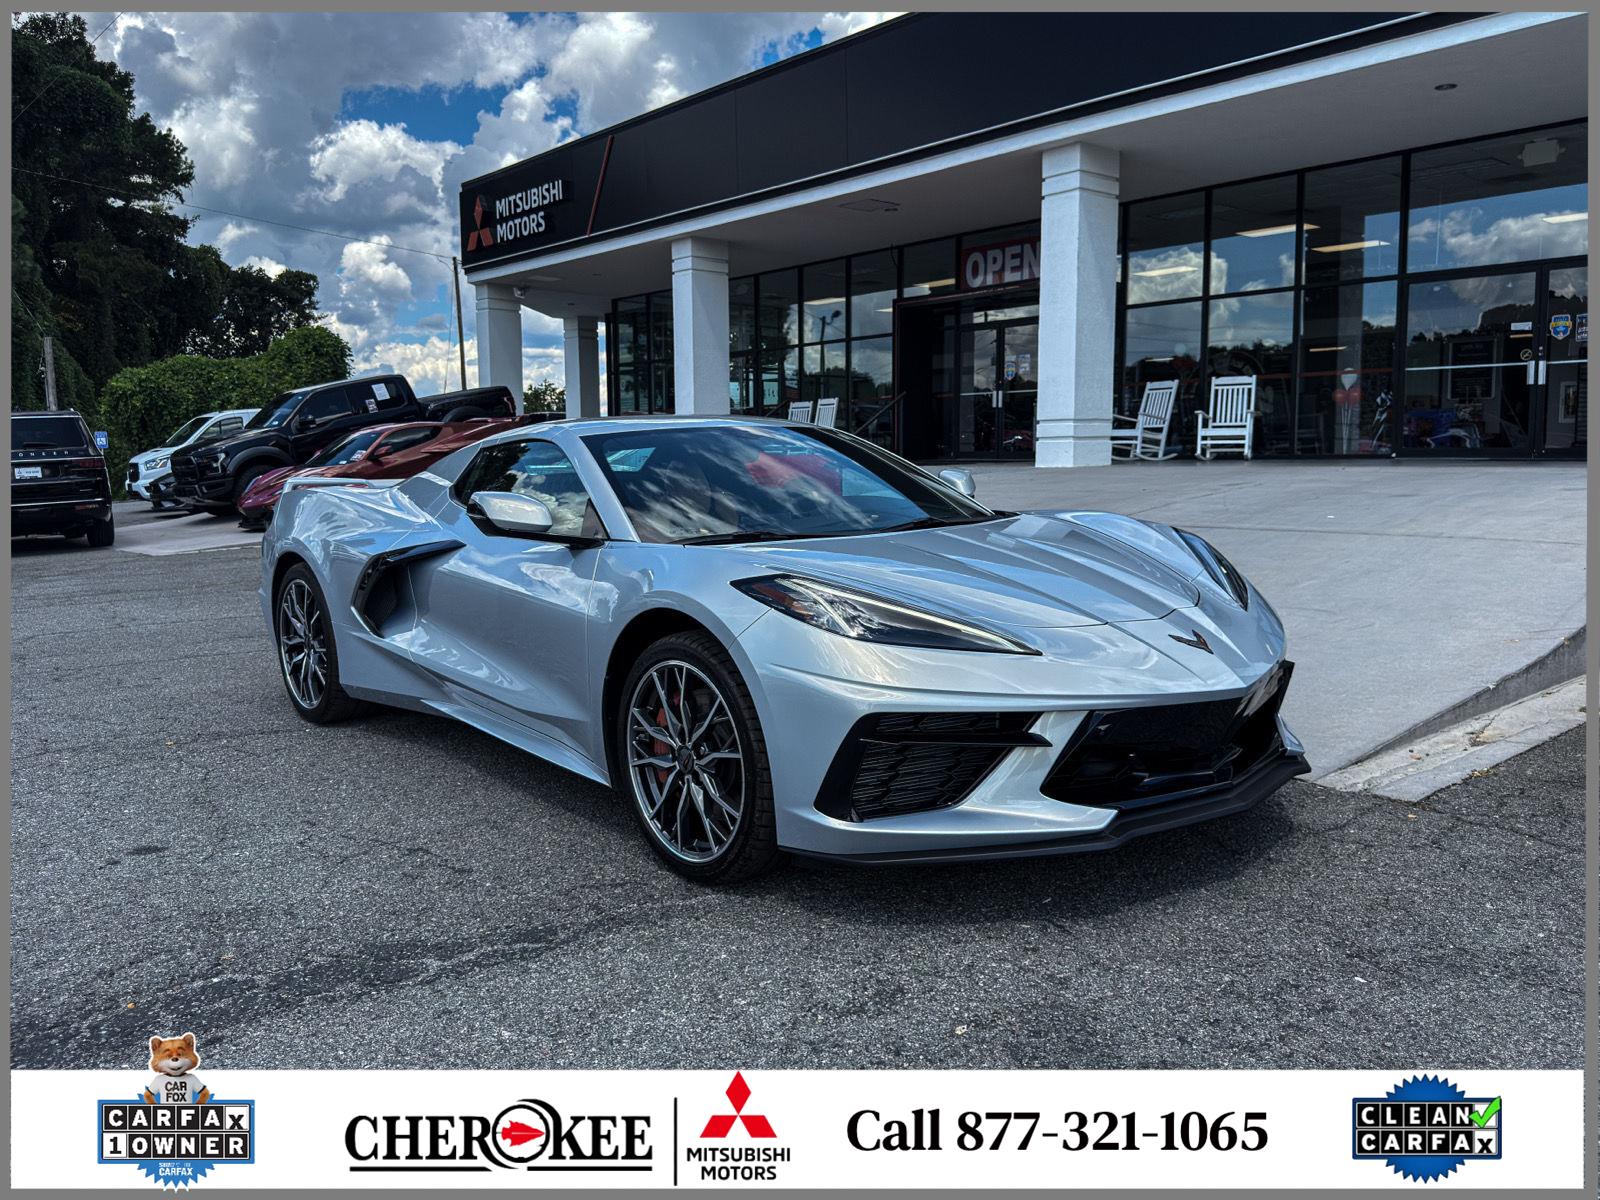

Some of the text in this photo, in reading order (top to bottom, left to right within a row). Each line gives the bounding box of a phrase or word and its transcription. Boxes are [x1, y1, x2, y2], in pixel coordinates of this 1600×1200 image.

[496, 180, 563, 219] MITSUBISHI
[497, 211, 546, 243] MOTORS
[966, 240, 1041, 288] OPEN
